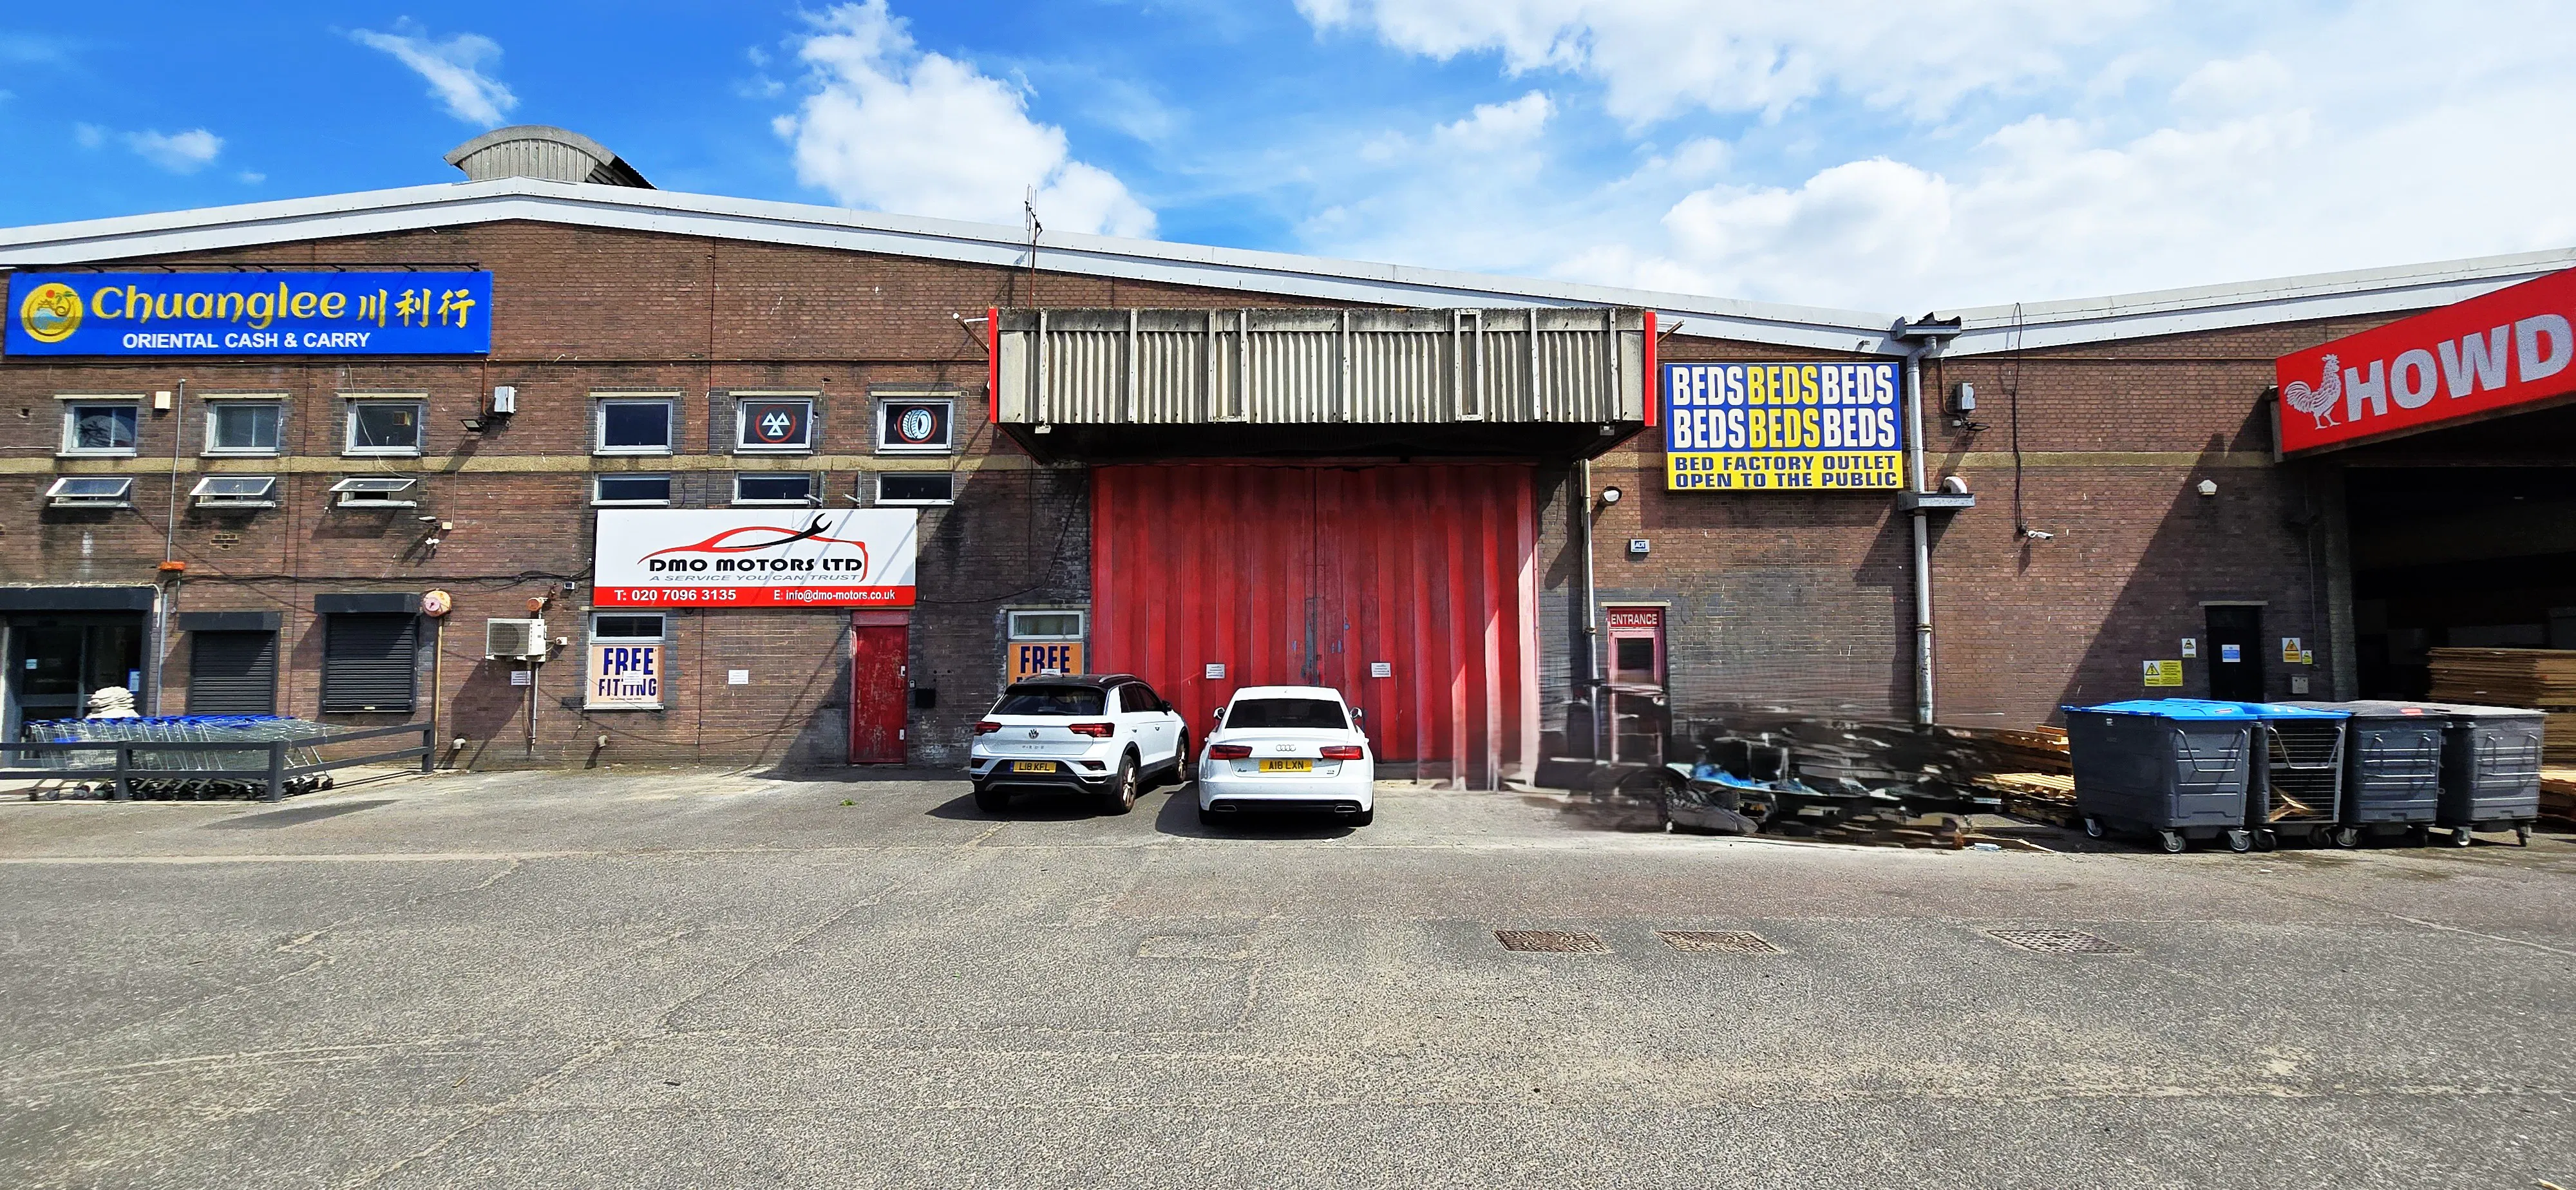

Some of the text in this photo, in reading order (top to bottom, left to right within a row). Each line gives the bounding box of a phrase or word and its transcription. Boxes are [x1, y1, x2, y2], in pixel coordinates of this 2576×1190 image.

[91, 281, 346, 330] Chuanglee
[356, 288, 476, 328] 川利行
[122, 332, 371, 348] ORIENTAL CASH & CARRY
[2344, 314, 2575, 422] HOWD
[1672, 365, 1894, 406] BEDS BEDS BEDS
[1673, 407, 1896, 448] BEDS BEDS BEDS
[1675, 455, 1896, 471] BED FACTORY OUTLET
[1676, 471, 1897, 487] OPEN TO THE PUBLIC
[649, 558, 863, 572] DMO MOTORS LTD
[614, 589, 737, 601] T: 020 7096 3135
[773, 589, 895, 603] E: info@dmo-motors.co.uk
[1611, 613, 1658, 625] ENTRANCE
[1034, 762, 1050, 771] KFL
[1285, 761, 1304, 770] LXN
